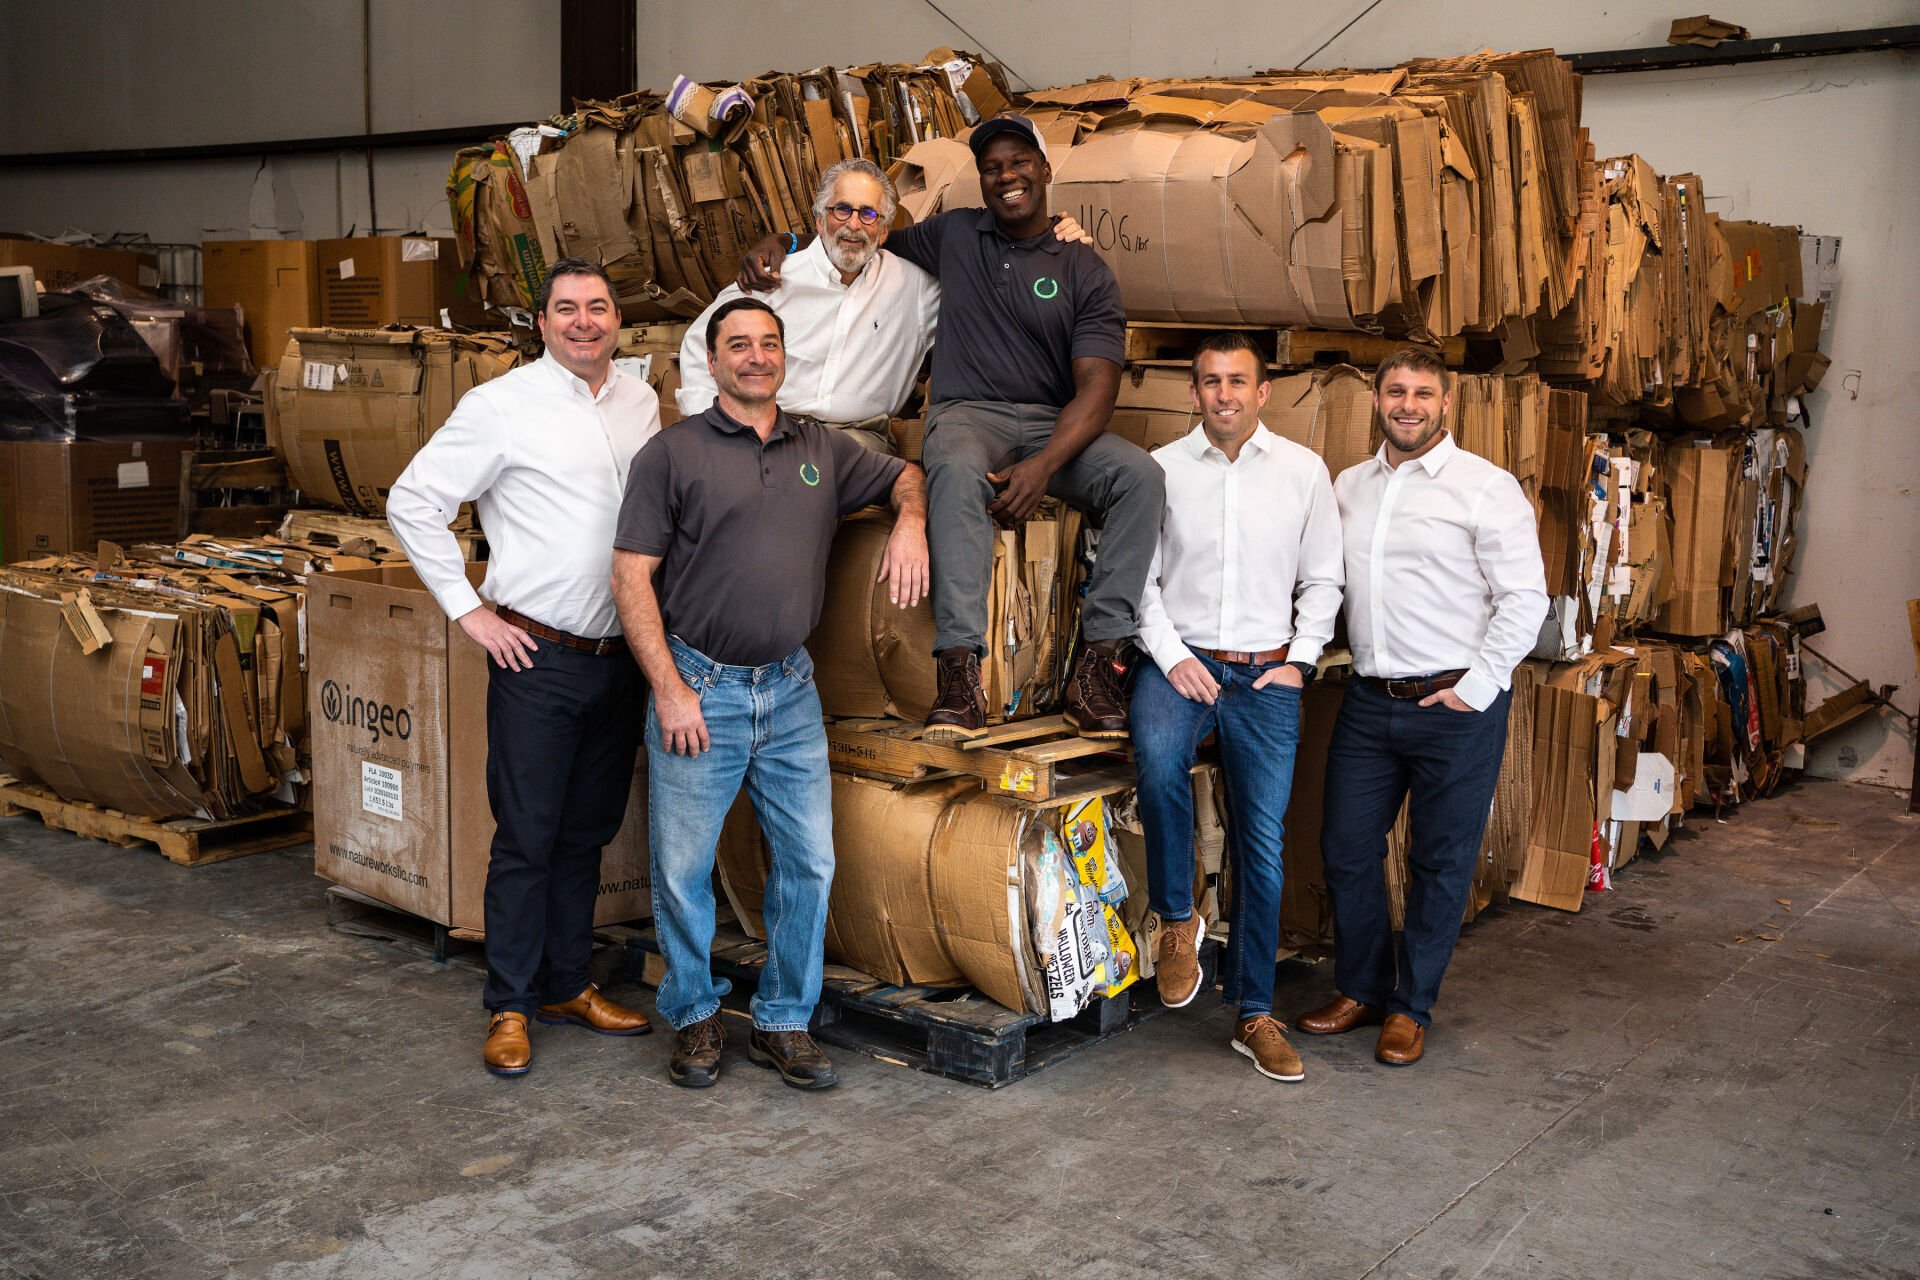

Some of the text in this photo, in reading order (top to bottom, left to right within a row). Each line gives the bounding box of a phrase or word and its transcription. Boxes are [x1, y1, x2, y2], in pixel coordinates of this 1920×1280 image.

[346, 684, 411, 743] ingeo
[346, 743, 370, 760] naturally
[401, 759, 431, 775] polymers
[329, 842, 428, 888] www.natureworksllc.com
[1047, 953, 1064, 1000] PRETZELS
[1058, 928, 1076, 986] HALLOWEEN
